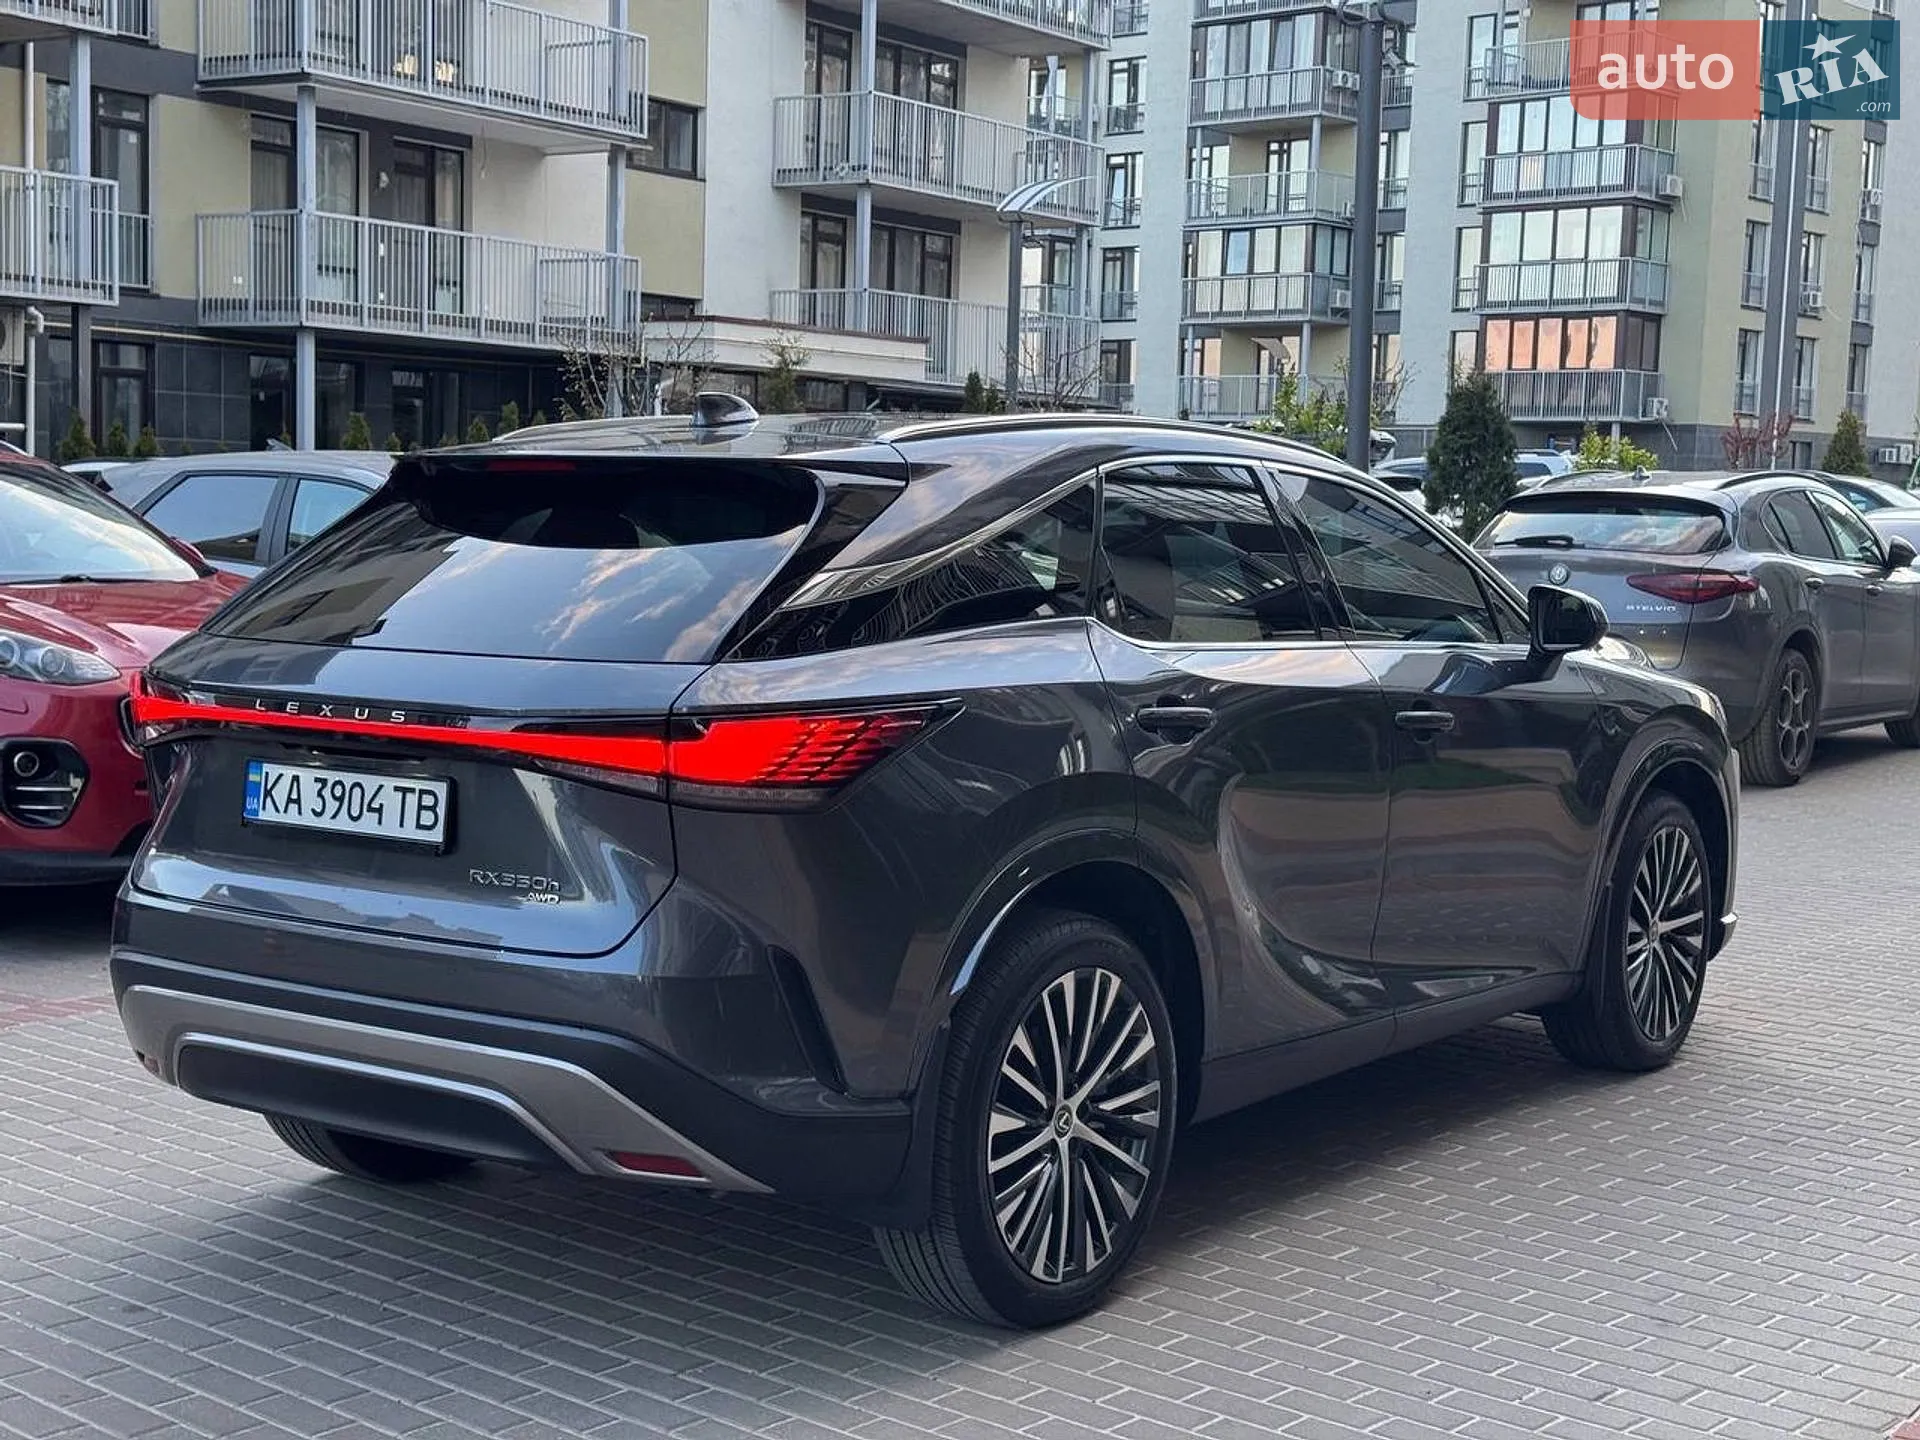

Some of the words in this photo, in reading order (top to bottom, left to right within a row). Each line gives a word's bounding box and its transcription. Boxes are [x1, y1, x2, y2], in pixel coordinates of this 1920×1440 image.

[255, 698, 406, 723] LEXUS
[245, 796, 259, 811] UA
[261, 771, 303, 816] KA
[310, 777, 385, 827] 3904
[393, 785, 439, 831] TB
[527, 891, 560, 905] AWD
